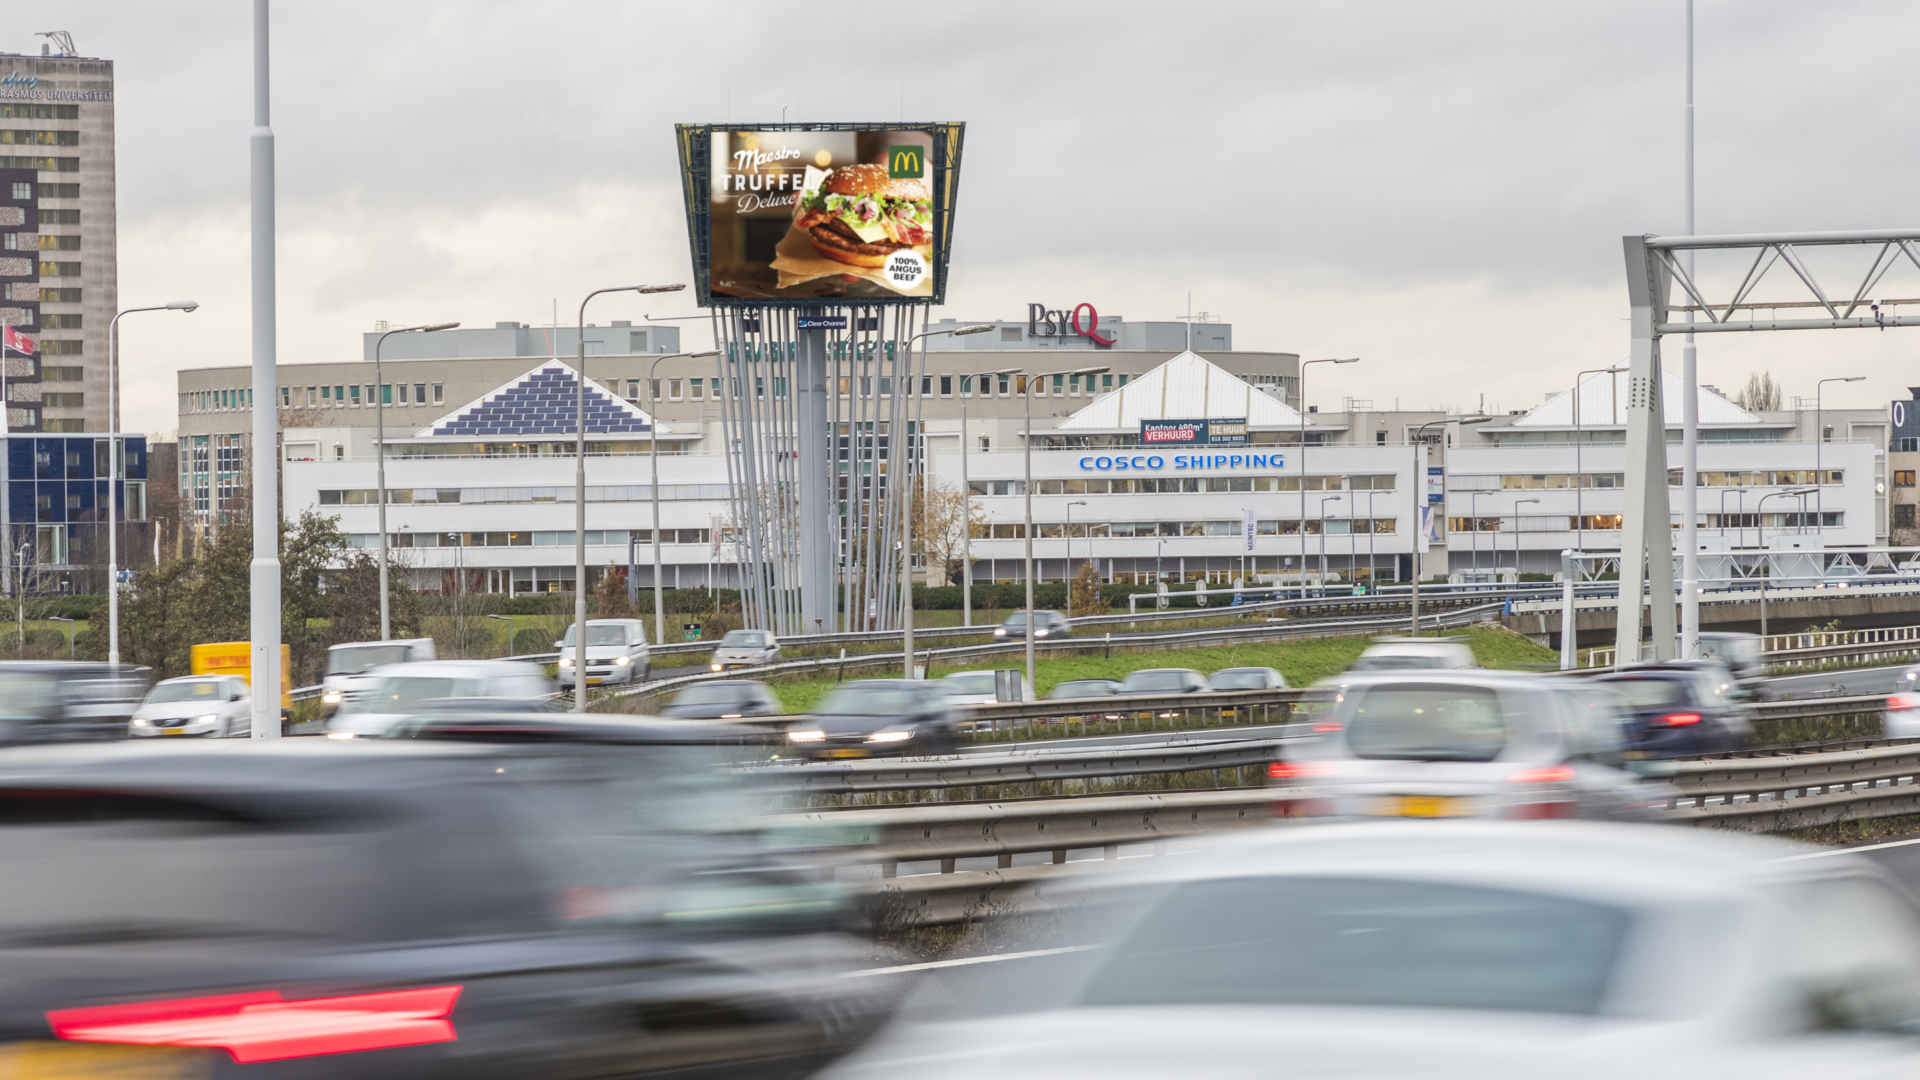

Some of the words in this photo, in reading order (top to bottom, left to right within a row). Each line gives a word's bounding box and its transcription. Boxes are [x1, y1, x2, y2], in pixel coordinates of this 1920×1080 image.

[46, 90, 112, 101] UNIVERSITEIT
[733, 145, 801, 174] Maestro
[720, 173, 816, 191] TRUFFEL
[736, 191, 798, 214] Deluxe
[893, 257, 919, 266] 100%
[889, 264, 922, 274] ANGUS
[893, 273, 916, 281] BEEF
[1211, 425, 1221, 434] TE
[1223, 425, 1245, 434] HUUR
[1146, 430, 1194, 441] VERHUURD
[1079, 455, 1164, 471] COSCO
[1174, 454, 1285, 470] SHIPPING
